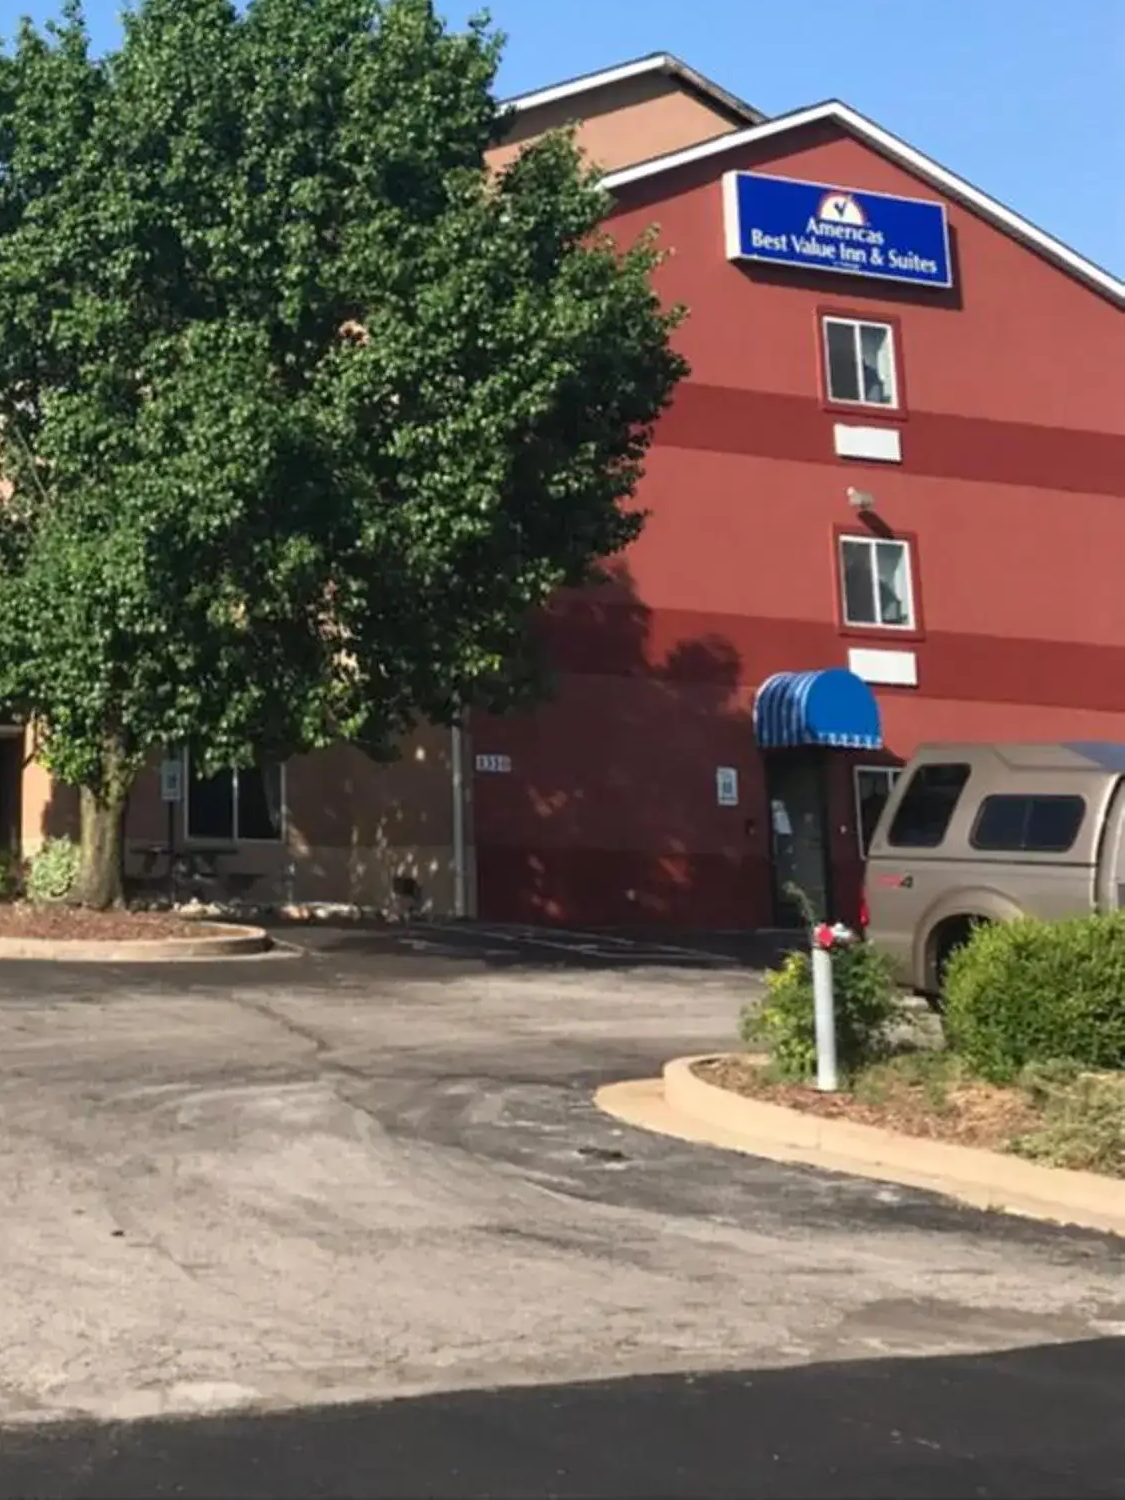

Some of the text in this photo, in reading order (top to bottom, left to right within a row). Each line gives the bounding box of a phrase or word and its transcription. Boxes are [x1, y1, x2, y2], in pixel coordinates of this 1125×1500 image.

[805, 217, 884, 244] Americas
[751, 228, 937, 274] Best Value Inn & Suites
